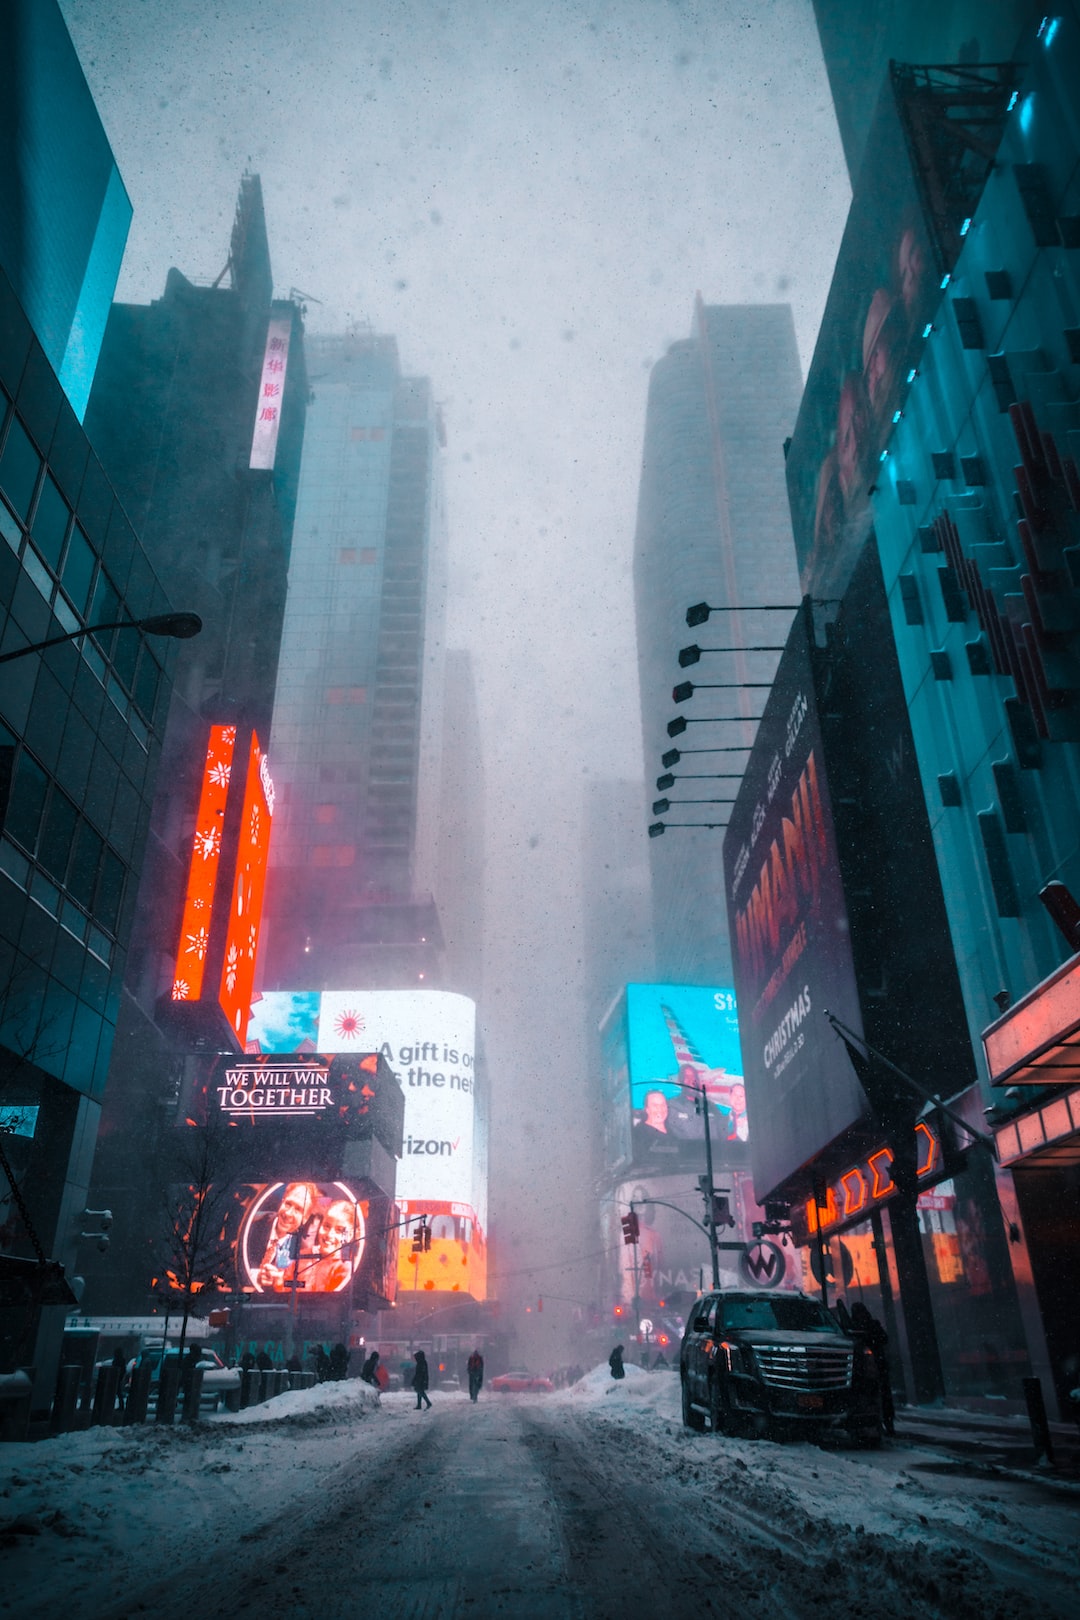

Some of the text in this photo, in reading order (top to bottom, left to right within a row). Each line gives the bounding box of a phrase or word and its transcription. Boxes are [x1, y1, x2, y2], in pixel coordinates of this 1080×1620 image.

[764, 985, 811, 1069] CHRISTMAS
[380, 1042, 394, 1061] A
[399, 1042, 439, 1066] gift
[443, 1043, 459, 1064] is
[225, 1071, 328, 1086] WE WILL WIN
[408, 1067, 446, 1087] the
[217, 1087, 335, 1107] TOGETHER
[744, 1252, 776, 1280] W
